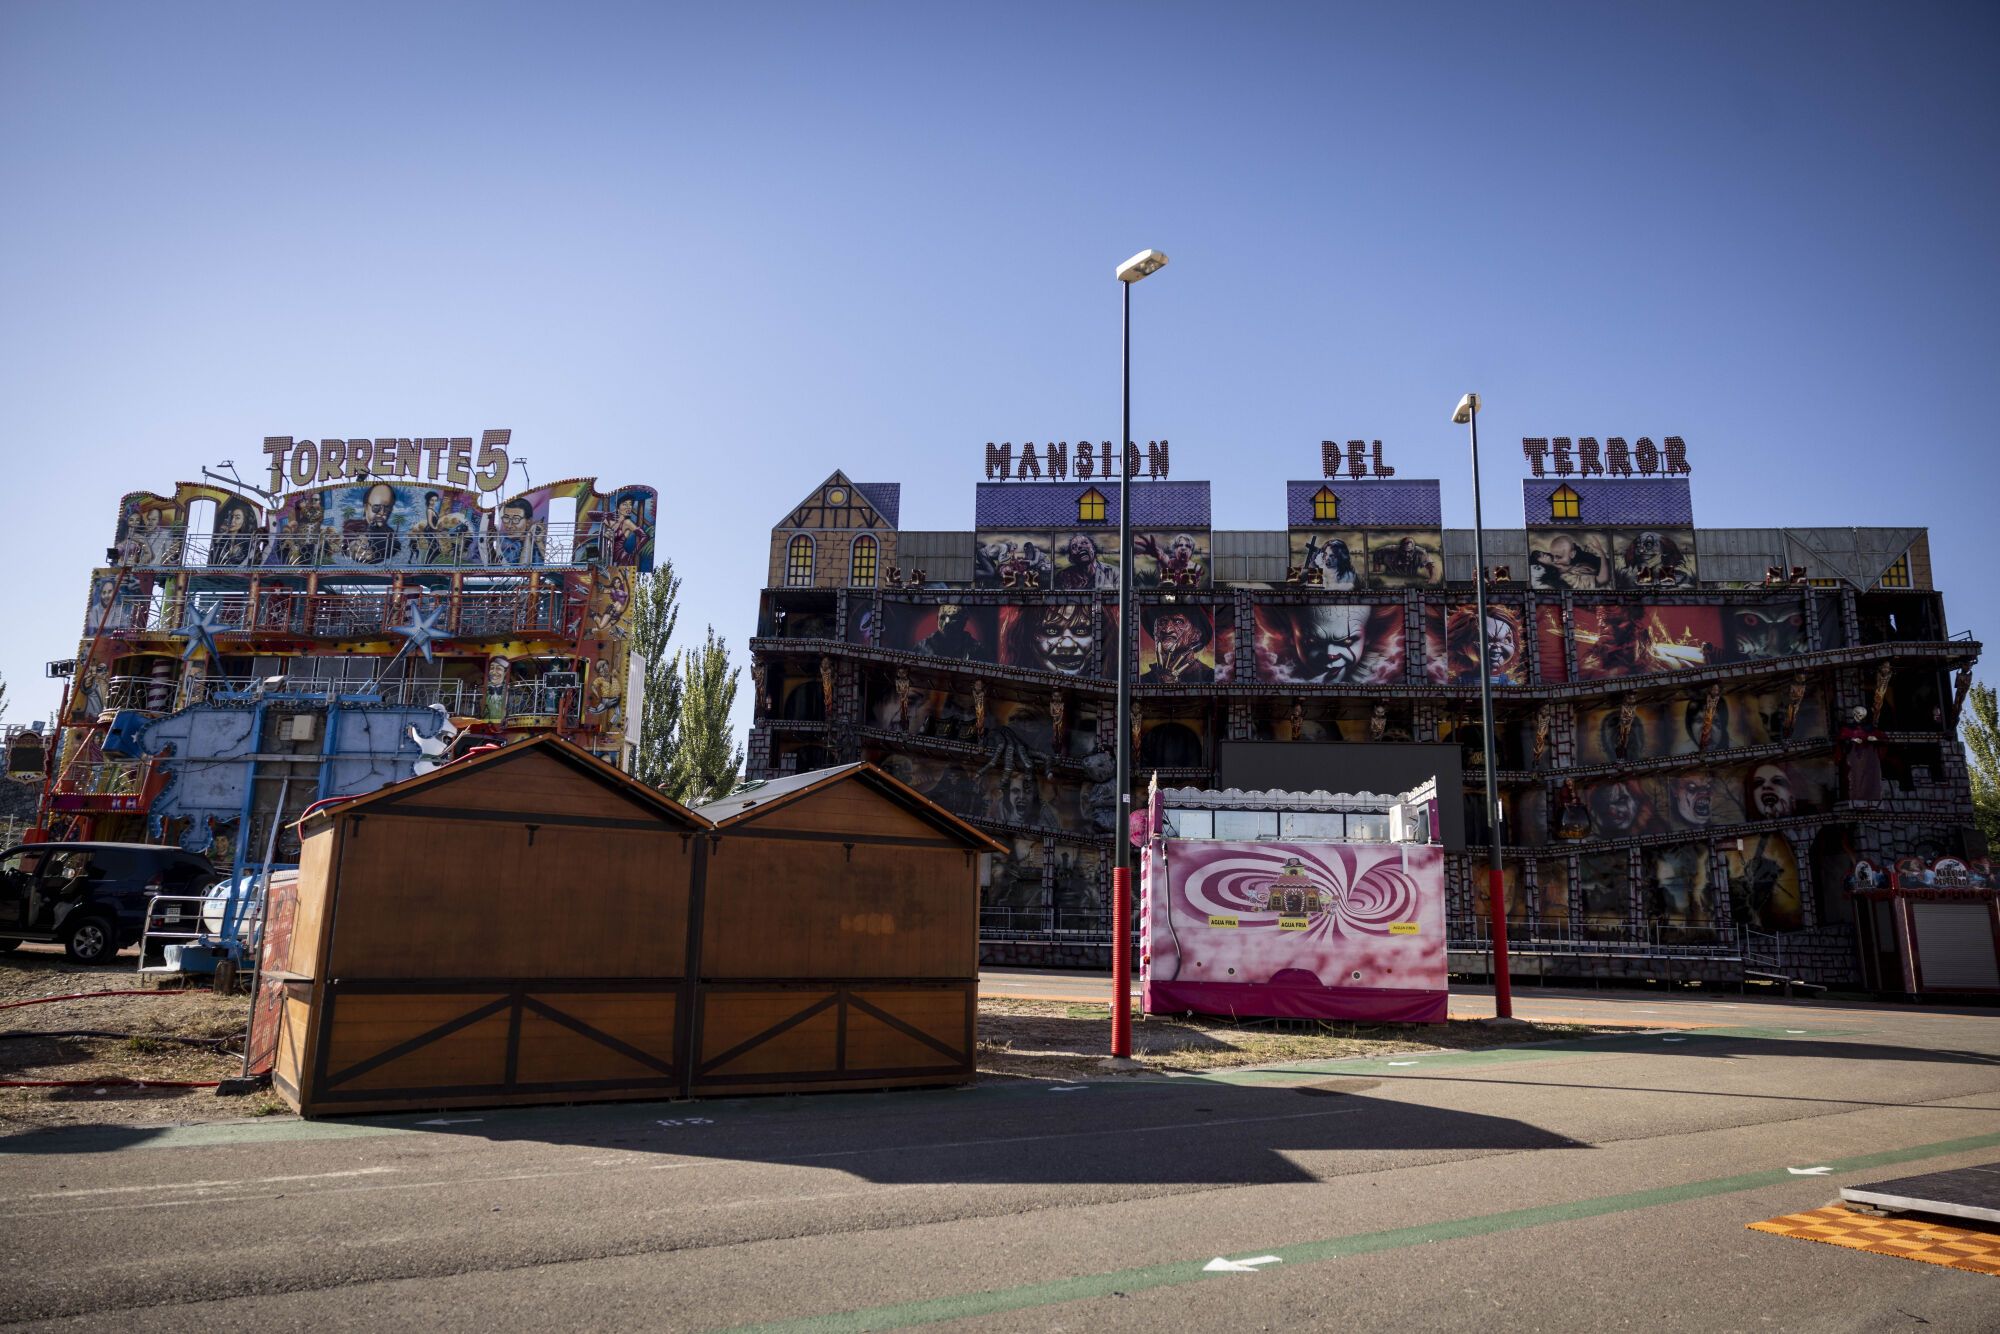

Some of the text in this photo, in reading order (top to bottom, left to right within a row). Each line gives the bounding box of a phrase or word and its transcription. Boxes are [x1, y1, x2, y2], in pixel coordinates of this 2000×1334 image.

[263, 429, 512, 494] TORRENTE 5
[985, 436, 1692, 481] MANSION DEL TERROR
